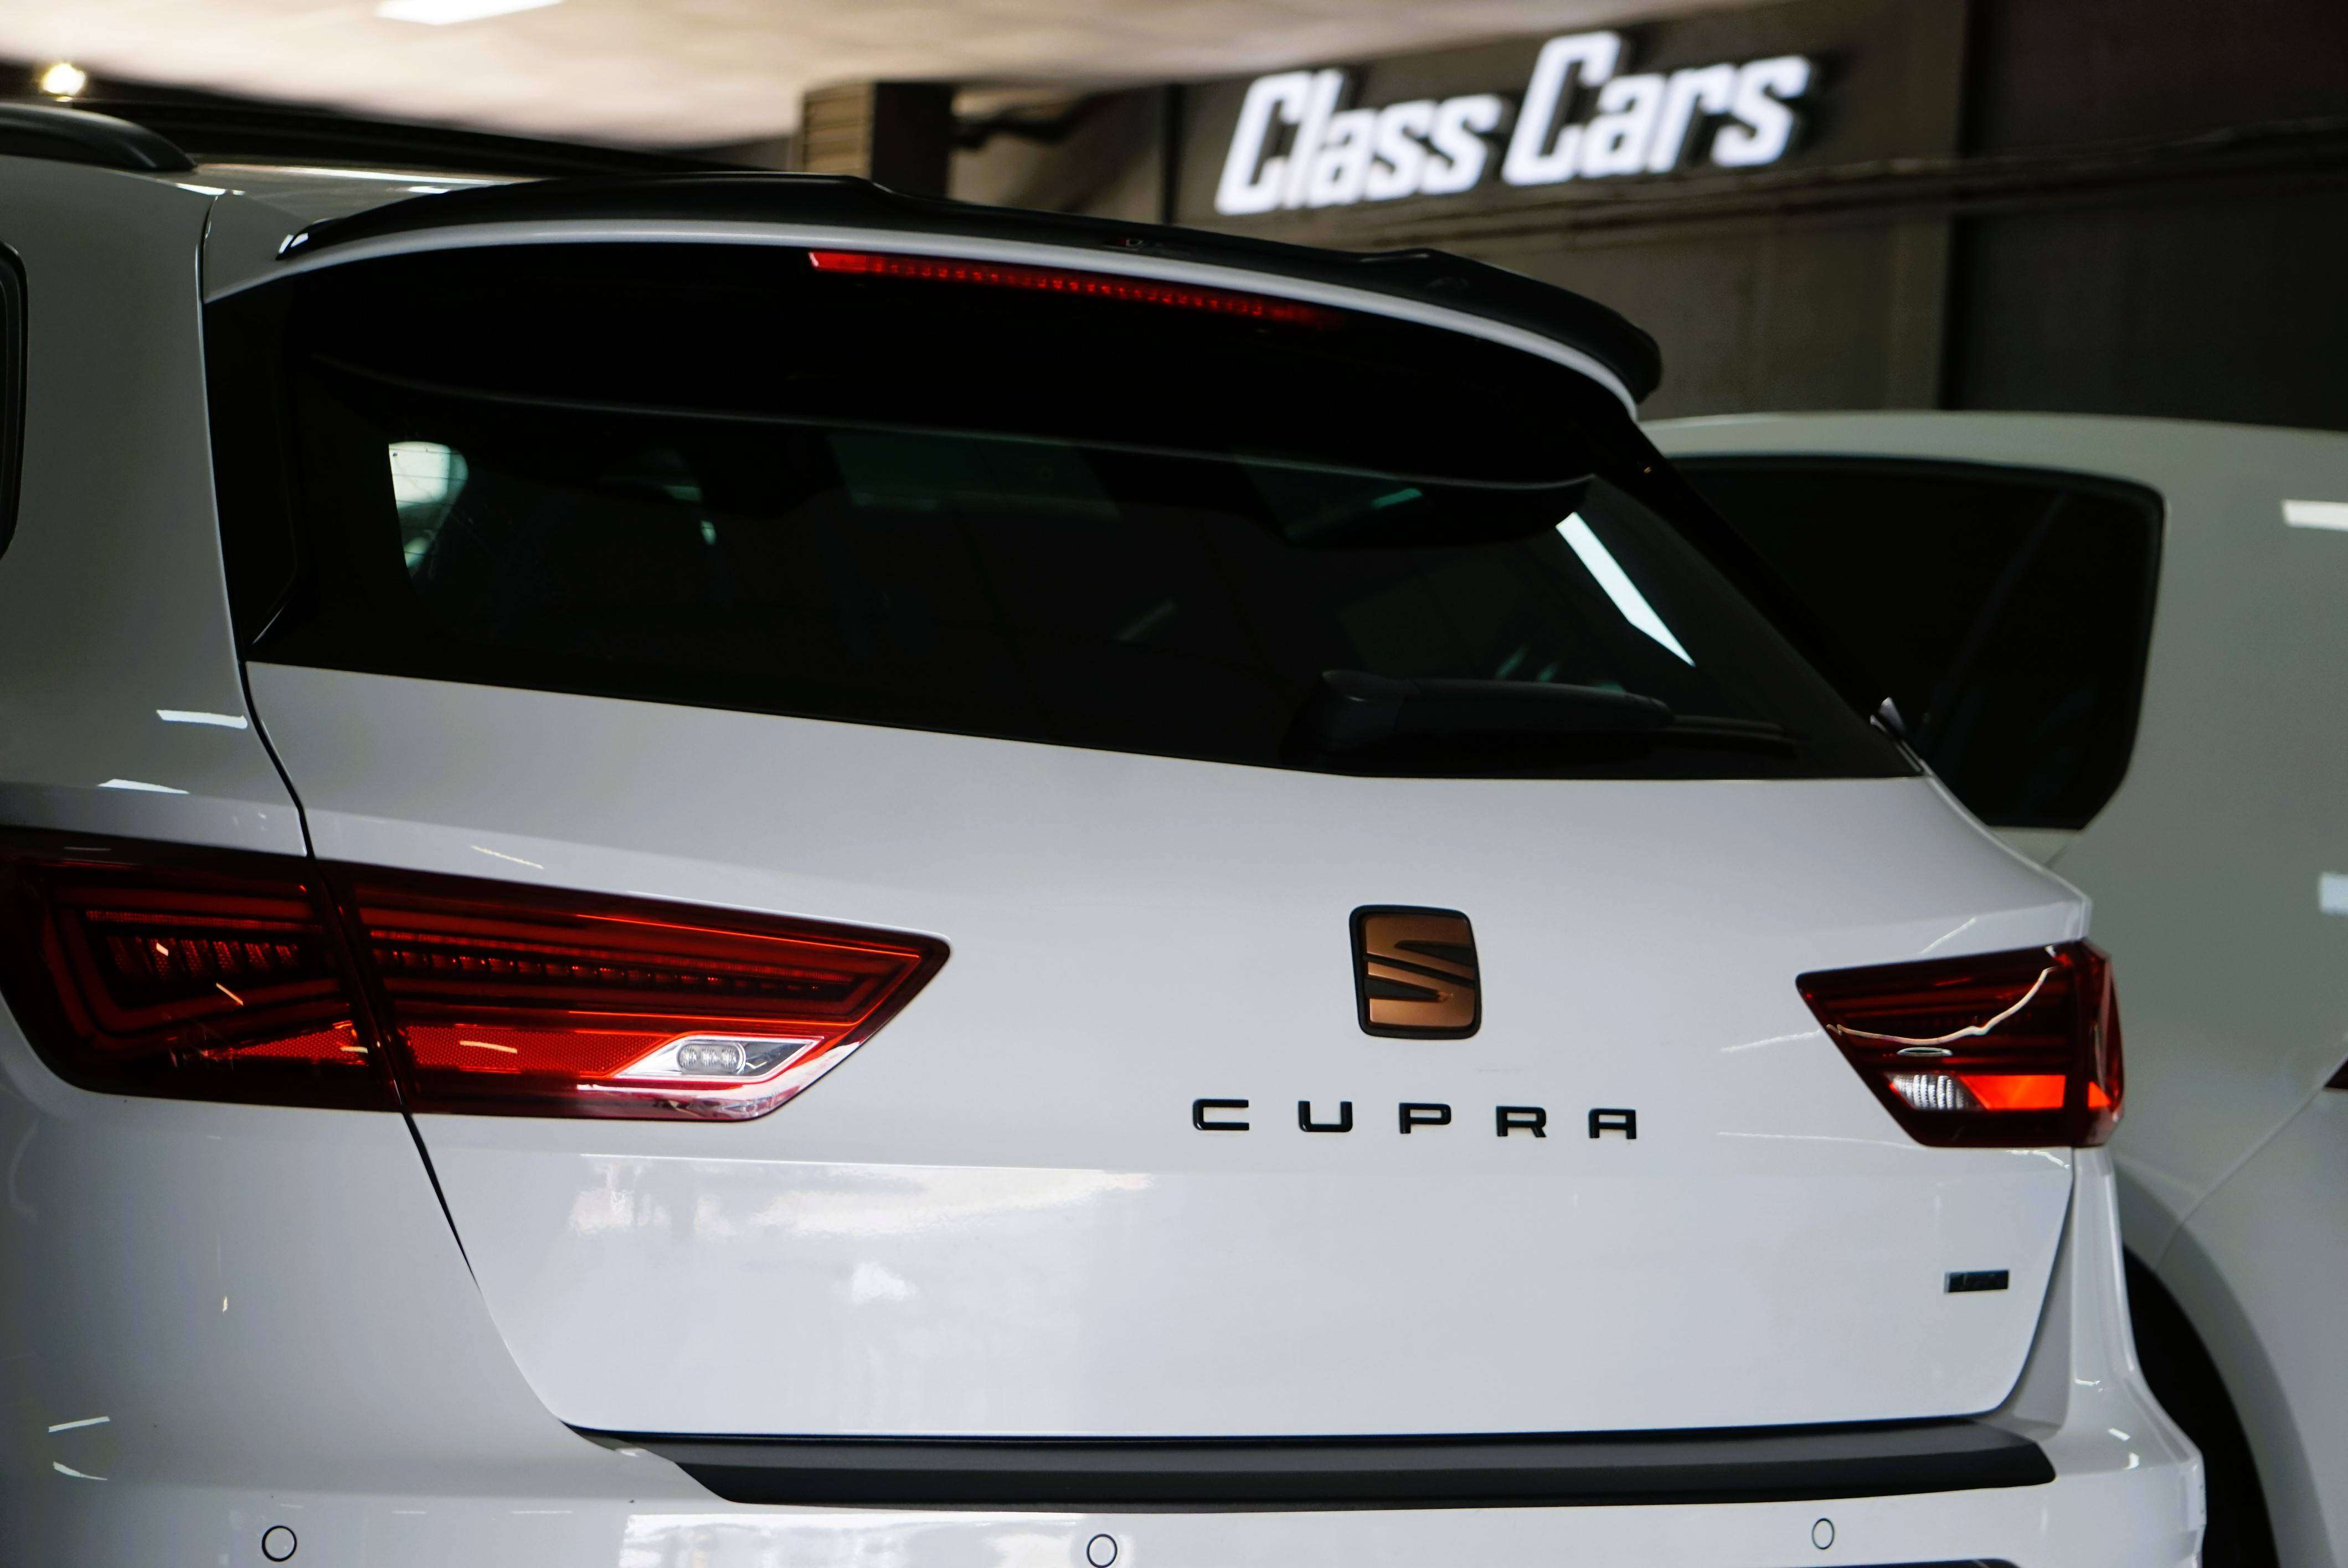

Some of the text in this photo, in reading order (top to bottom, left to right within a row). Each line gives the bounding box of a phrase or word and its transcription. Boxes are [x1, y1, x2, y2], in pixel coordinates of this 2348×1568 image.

[1216, 31, 1810, 214] Class Cars
[1192, 1098, 1637, 1139] CUPRA
